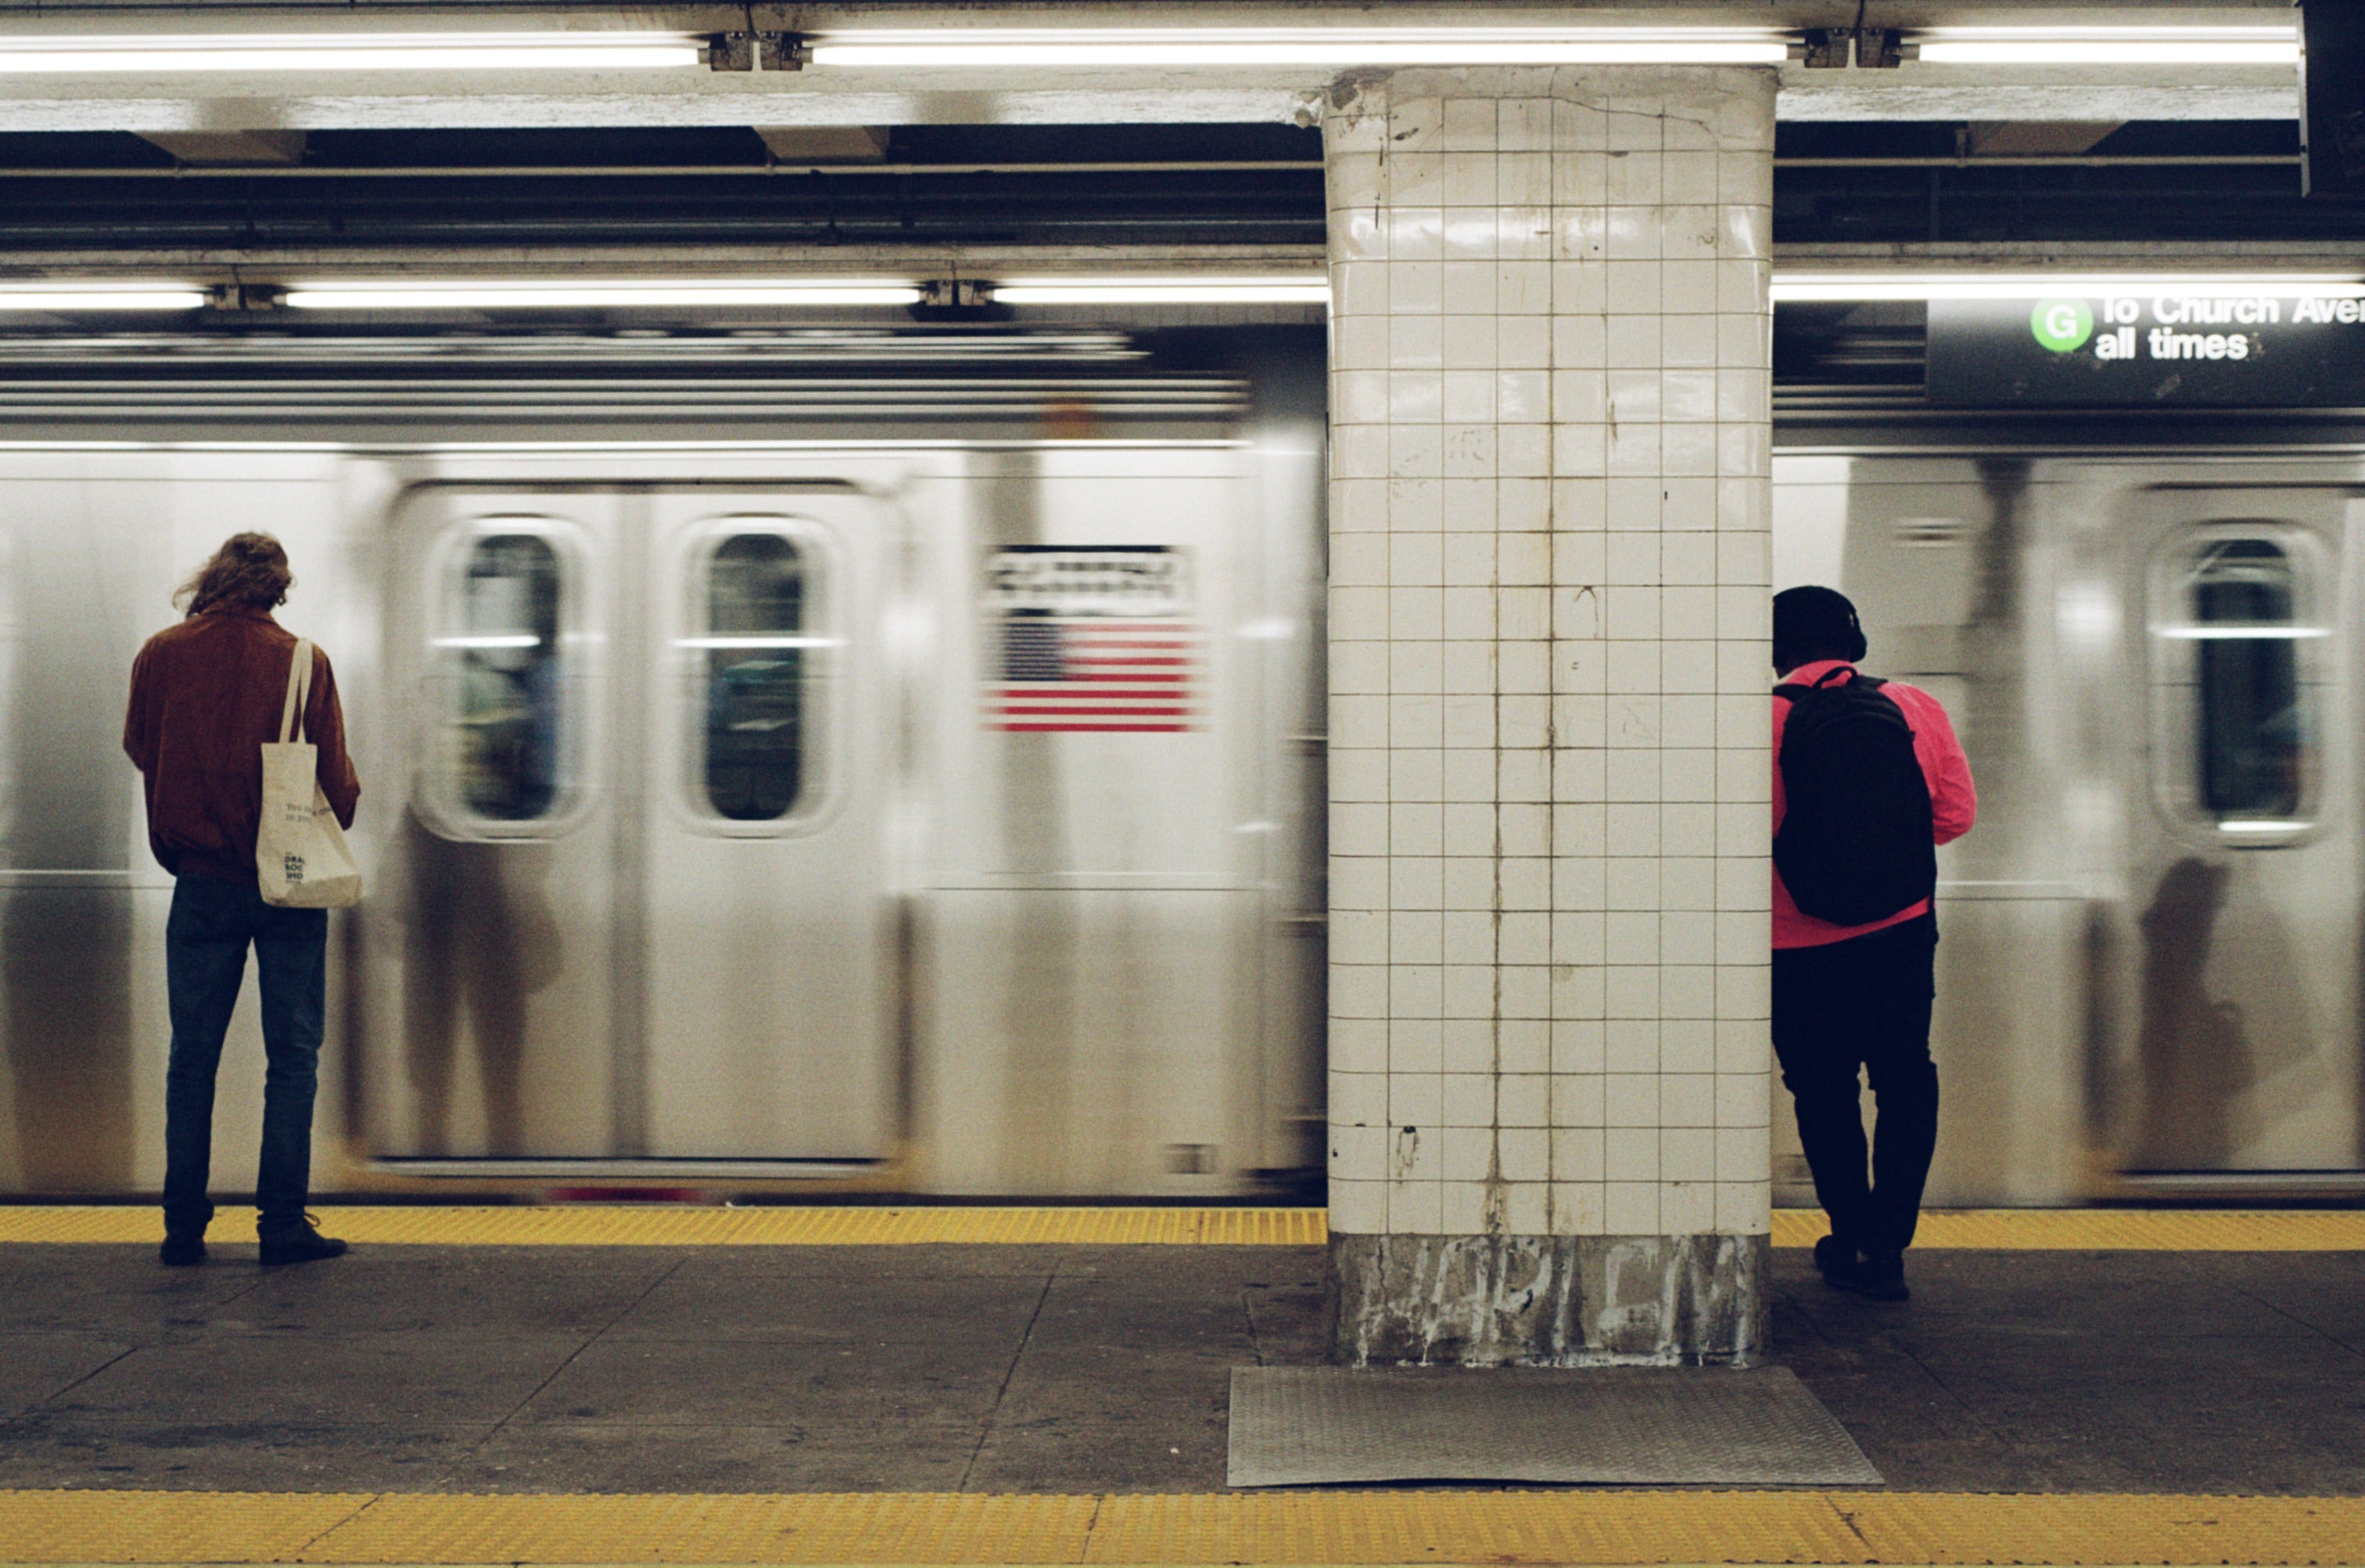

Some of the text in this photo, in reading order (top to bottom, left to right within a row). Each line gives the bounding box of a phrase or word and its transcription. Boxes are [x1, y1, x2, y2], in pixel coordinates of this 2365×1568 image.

[2045, 303, 2077, 339] G
[2152, 295, 2280, 324] Church
[2094, 326, 2249, 360] all times
